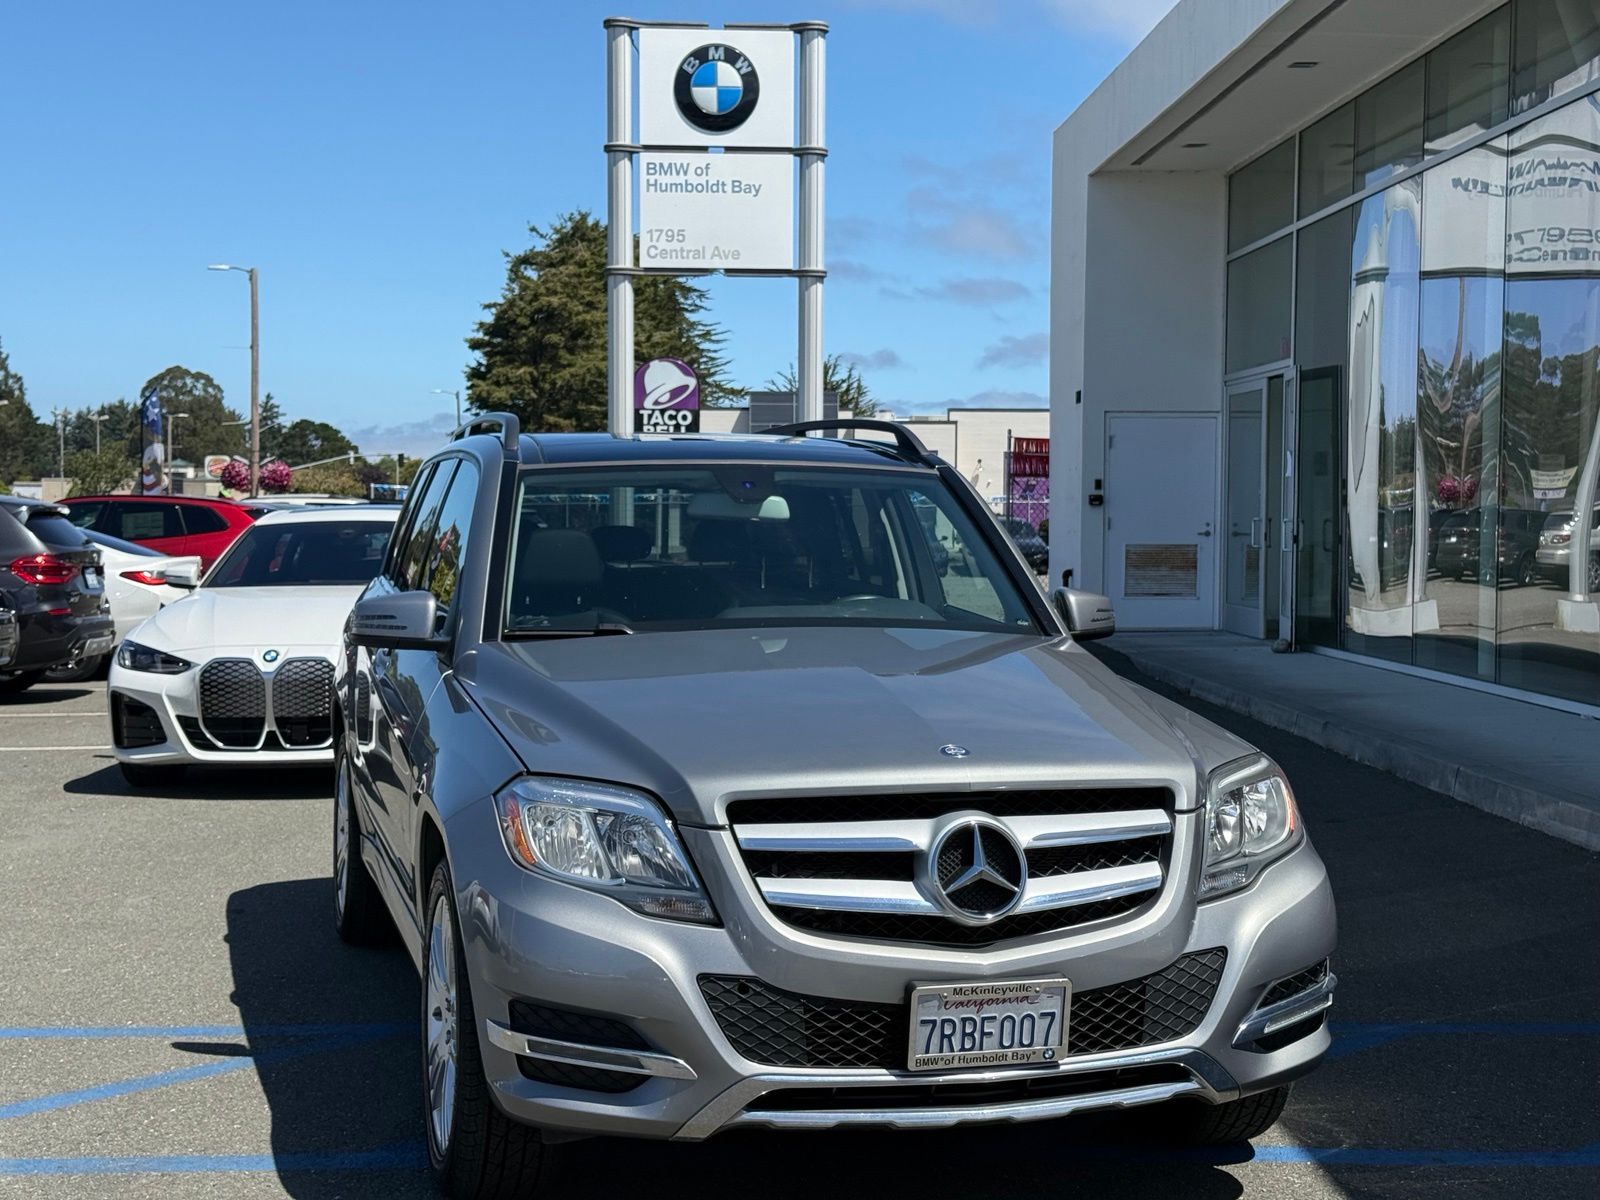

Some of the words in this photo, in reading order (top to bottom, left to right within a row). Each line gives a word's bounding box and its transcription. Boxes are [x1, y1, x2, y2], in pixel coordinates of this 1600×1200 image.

[682, 46, 752, 75] BMW
[646, 162, 690, 176] BMW
[694, 163, 711, 177] of
[646, 179, 727, 194] Humboldt
[731, 180, 762, 197] Bay
[646, 229, 686, 243] 1795
[646, 245, 706, 260] Central
[710, 246, 741, 260] Ave
[639, 410, 692, 426] TACO
[952, 984, 1032, 996] McKinleyville
[920, 1011, 1056, 1054] 7RBF007
[958, 1053, 1008, 1065] Humboldt
